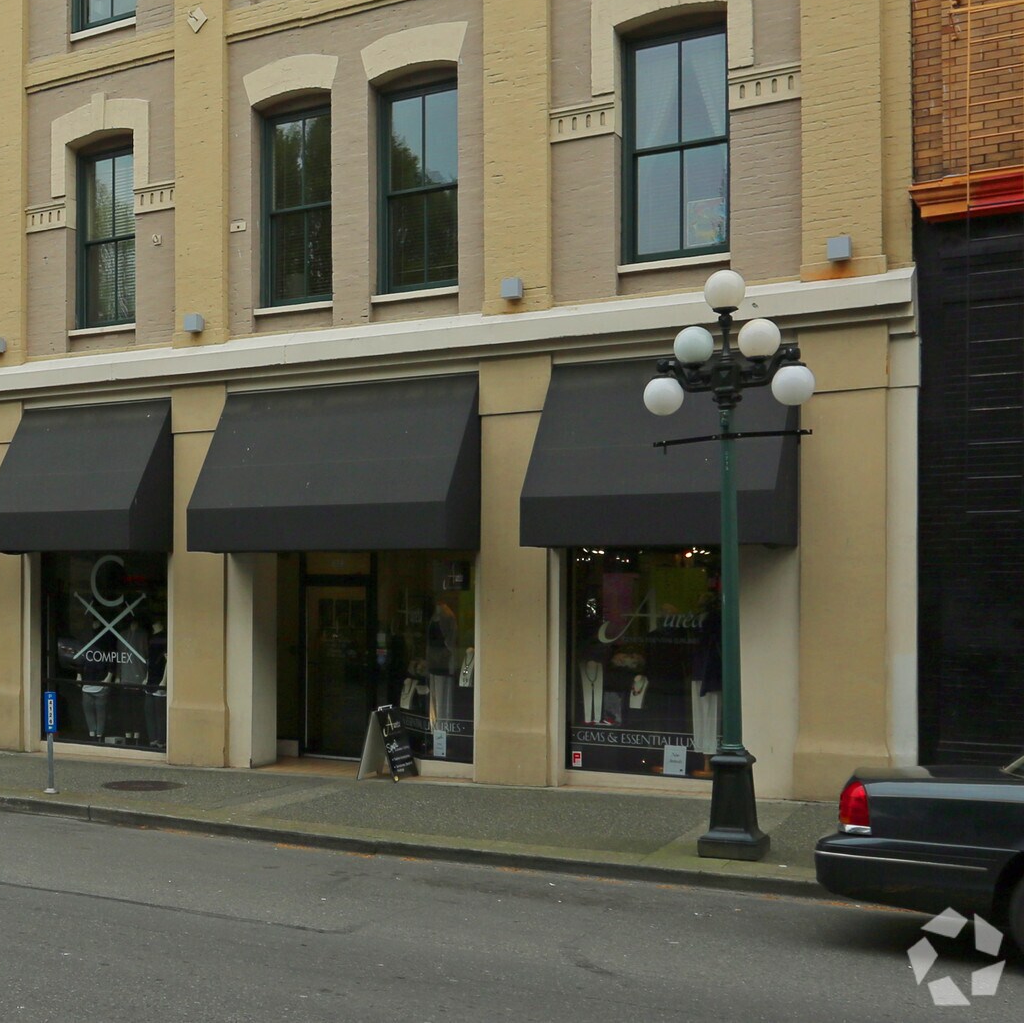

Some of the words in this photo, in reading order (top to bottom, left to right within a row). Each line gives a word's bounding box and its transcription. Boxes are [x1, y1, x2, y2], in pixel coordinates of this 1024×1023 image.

[84, 650, 133, 664] COMPLEX
[576, 730, 605, 743] GEMS
[607, 733, 618, 744] &
[620, 733, 672, 747] ESSENTIAL
